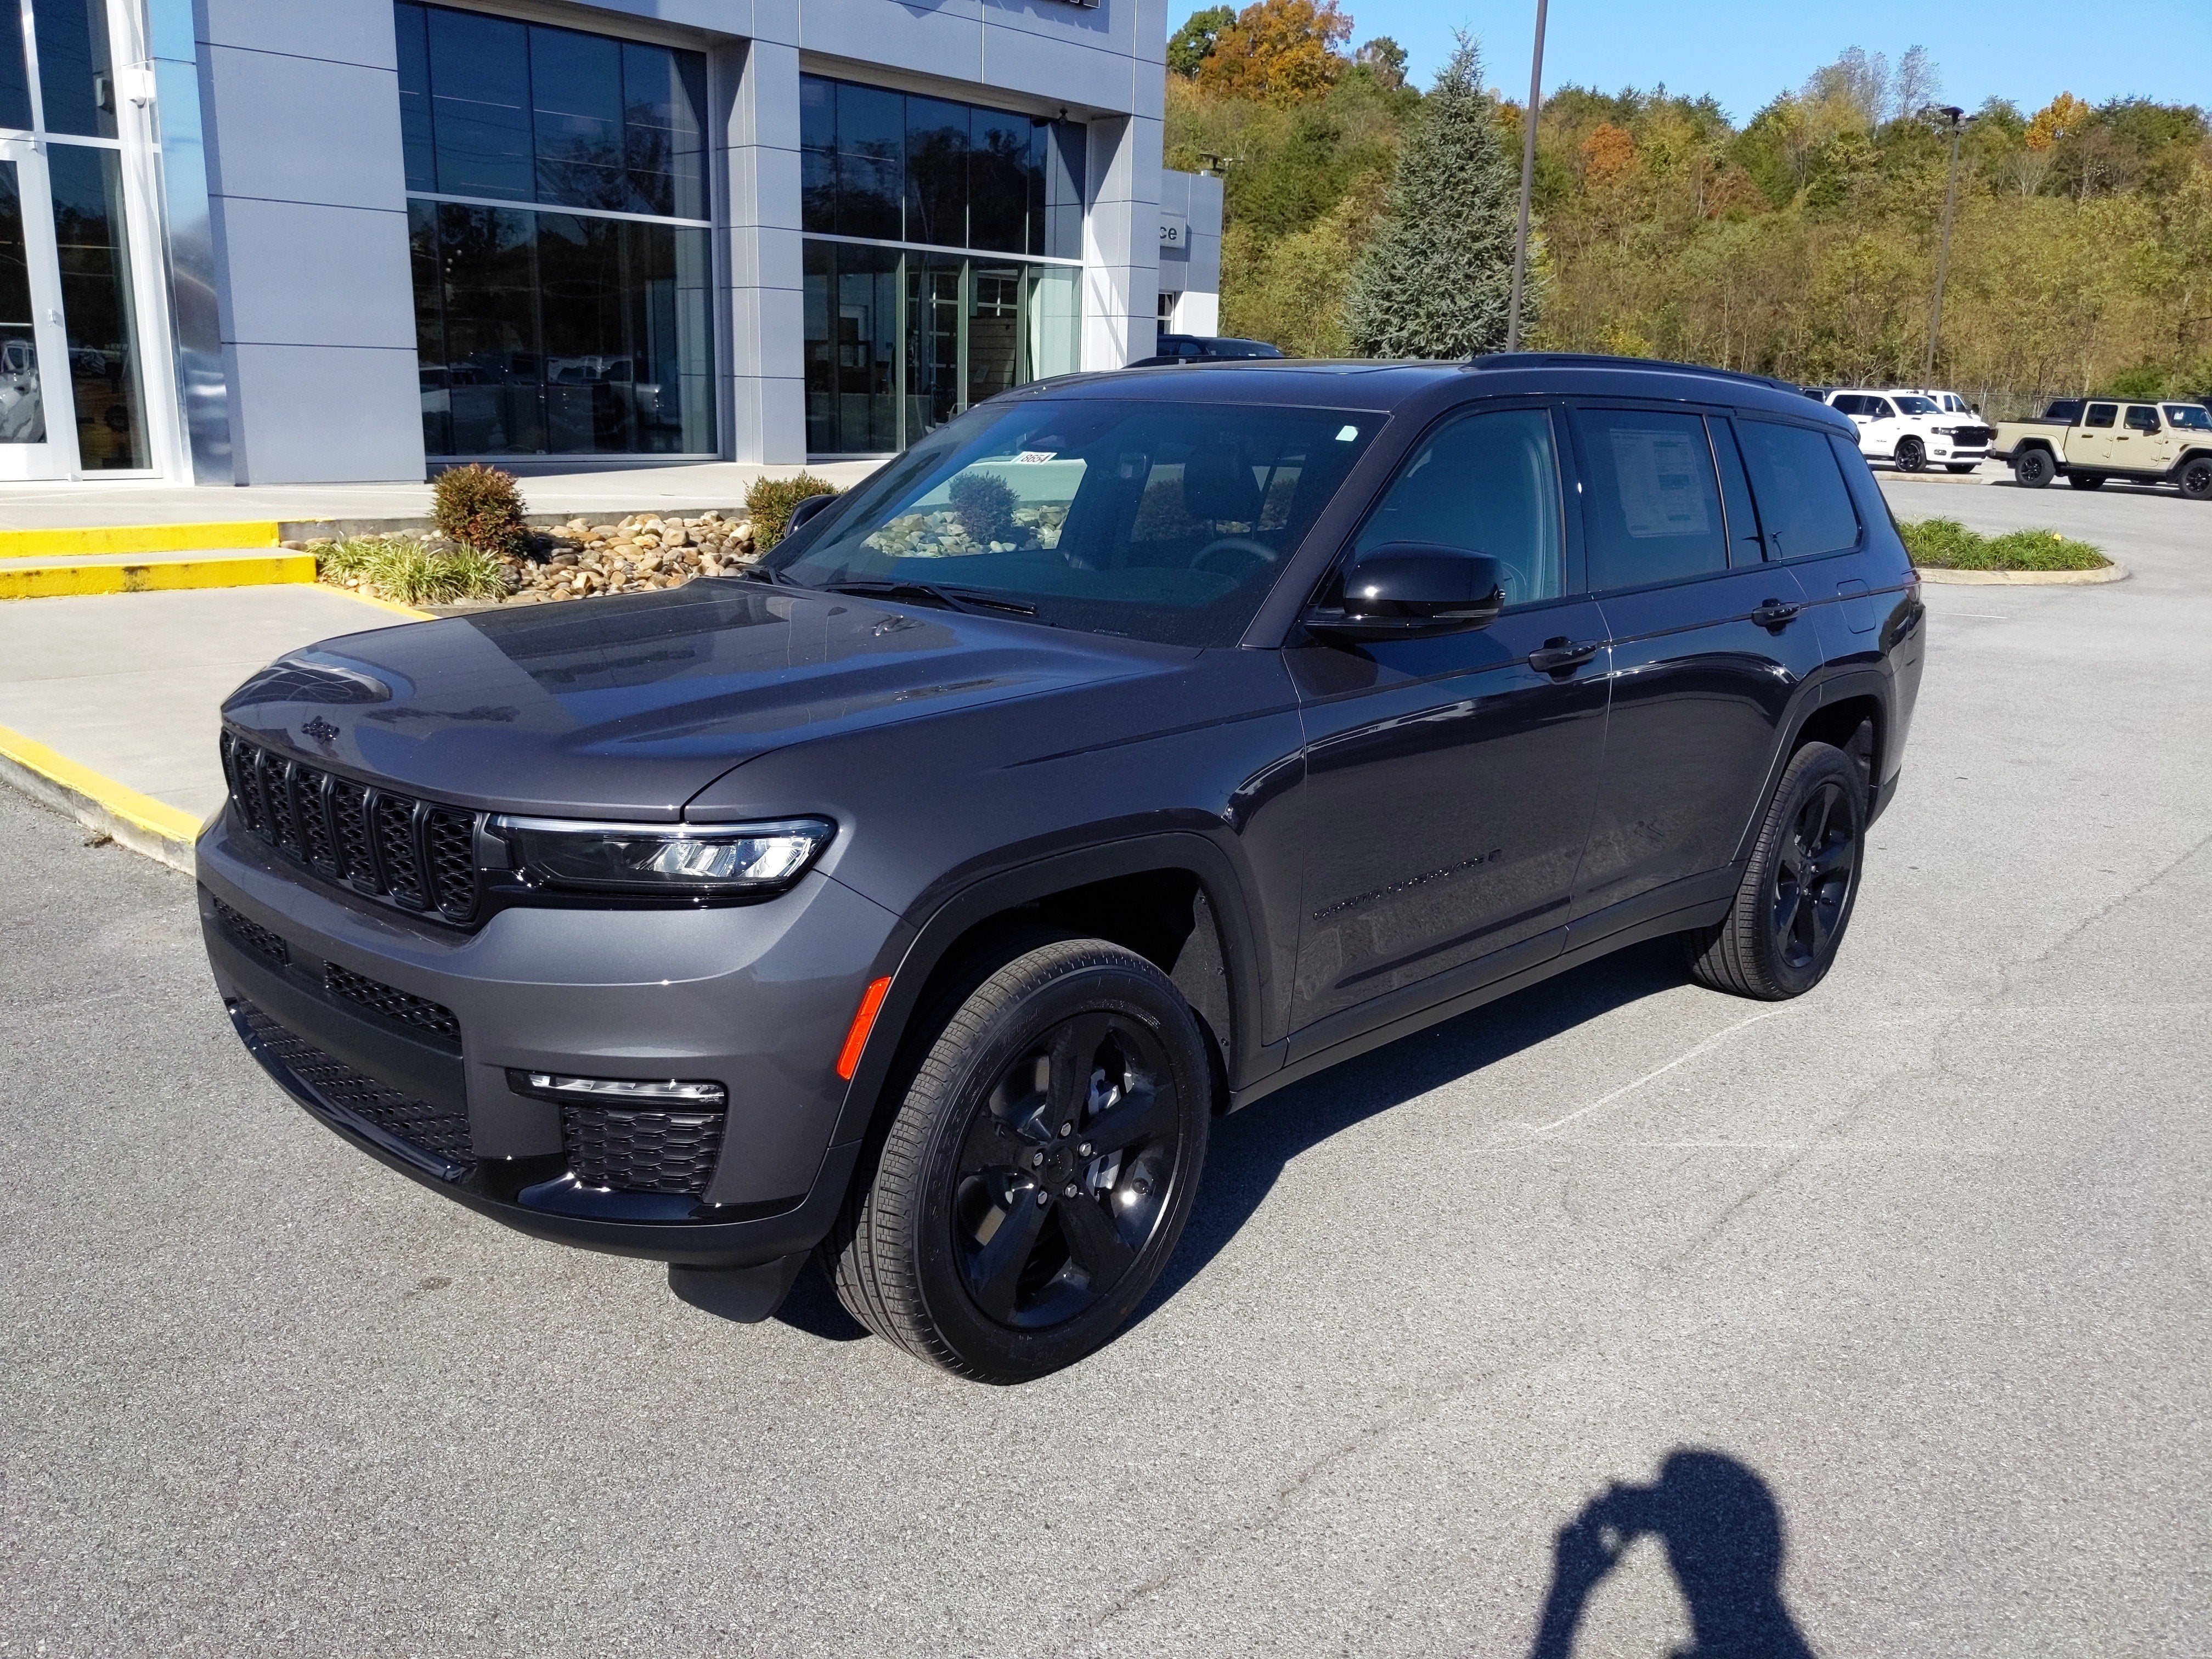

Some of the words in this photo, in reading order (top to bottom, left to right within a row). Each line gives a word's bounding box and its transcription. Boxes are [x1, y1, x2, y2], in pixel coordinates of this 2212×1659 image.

[1020, 454, 1051, 463] 8654
[302, 715, 341, 744] Jeep
[1313, 889, 1382, 920] GRAND
[1387, 854, 1484, 893] CHEROKEE
